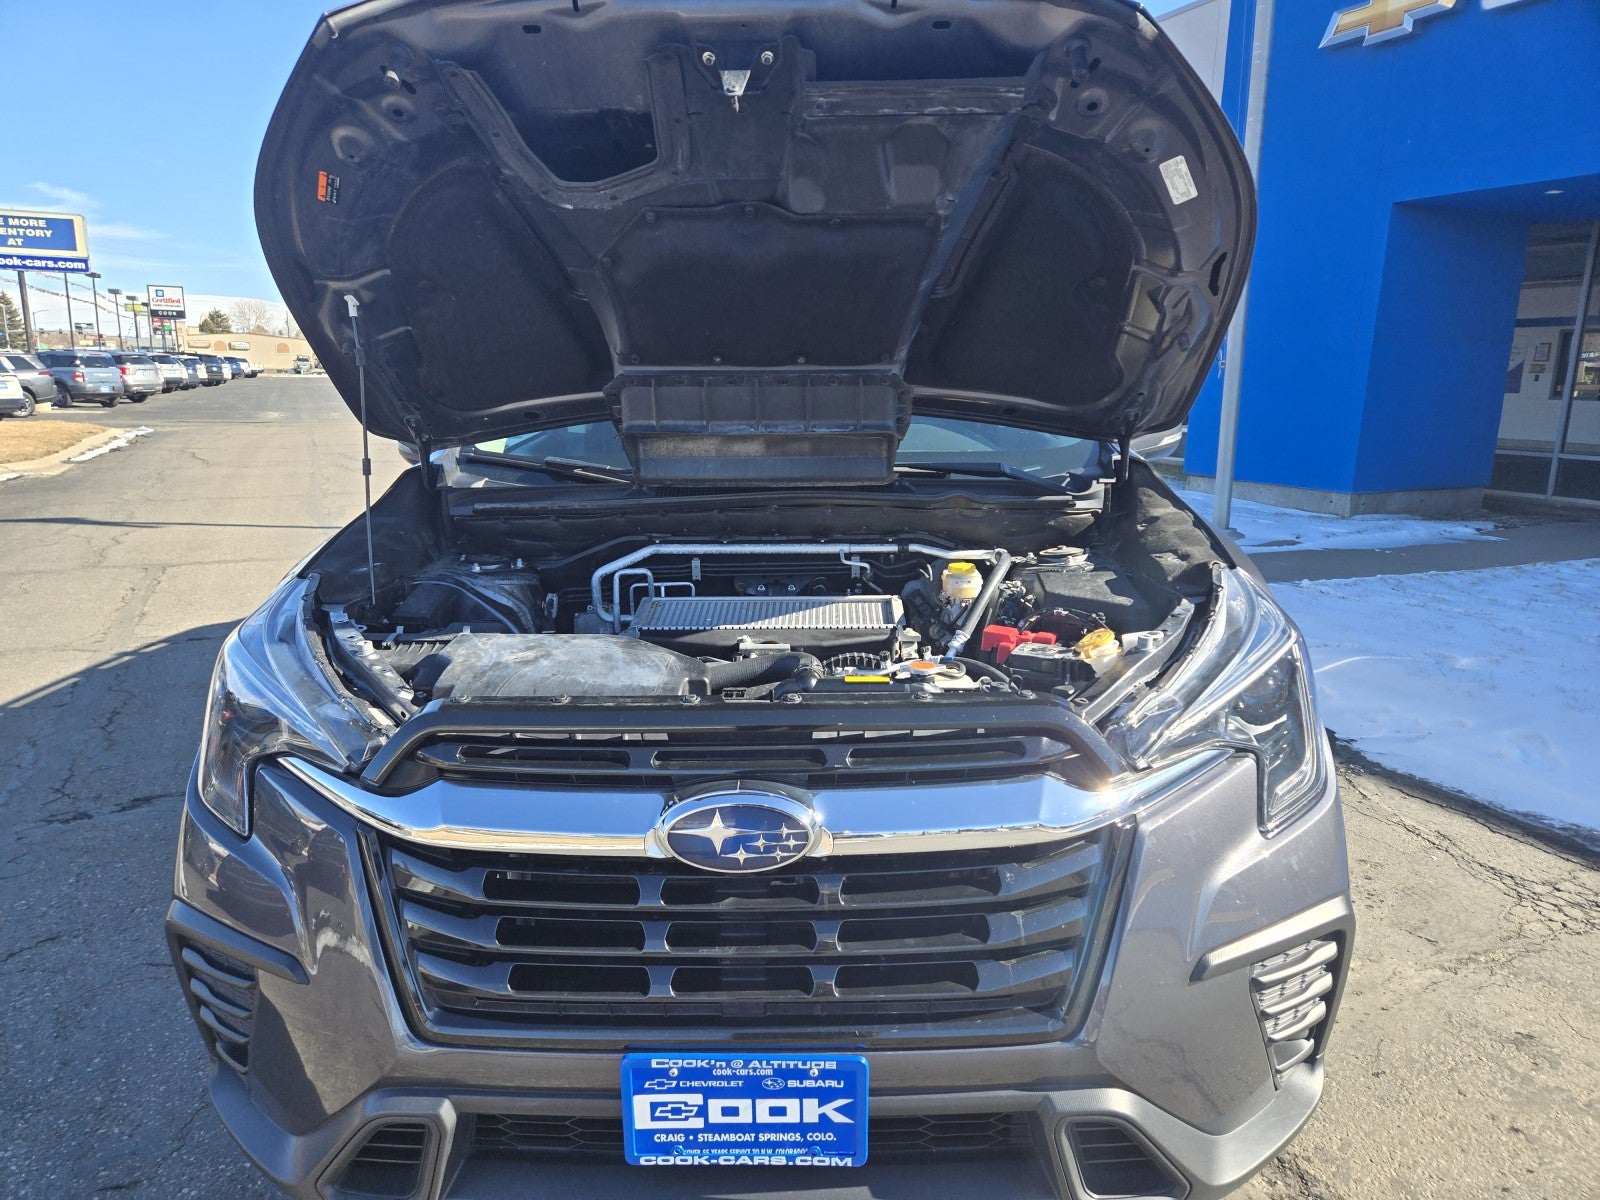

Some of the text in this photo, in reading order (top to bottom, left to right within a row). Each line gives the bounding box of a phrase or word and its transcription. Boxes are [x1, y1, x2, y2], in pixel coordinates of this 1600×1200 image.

[8, 218, 47, 227] MORE
[7, 238, 24, 246] AT
[747, 1060, 837, 1070] ALTITUDE
[712, 1068, 774, 1076] cook-cars.com
[679, 1080, 744, 1088] CHEVROLET
[787, 1079, 845, 1089] SUBARU
[633, 1094, 855, 1130] COOK
[654, 1132, 838, 1143] CRAIG STEAMBOAT SPRINGS, COLO.
[639, 1156, 853, 1167] COOK-CARS.COM
